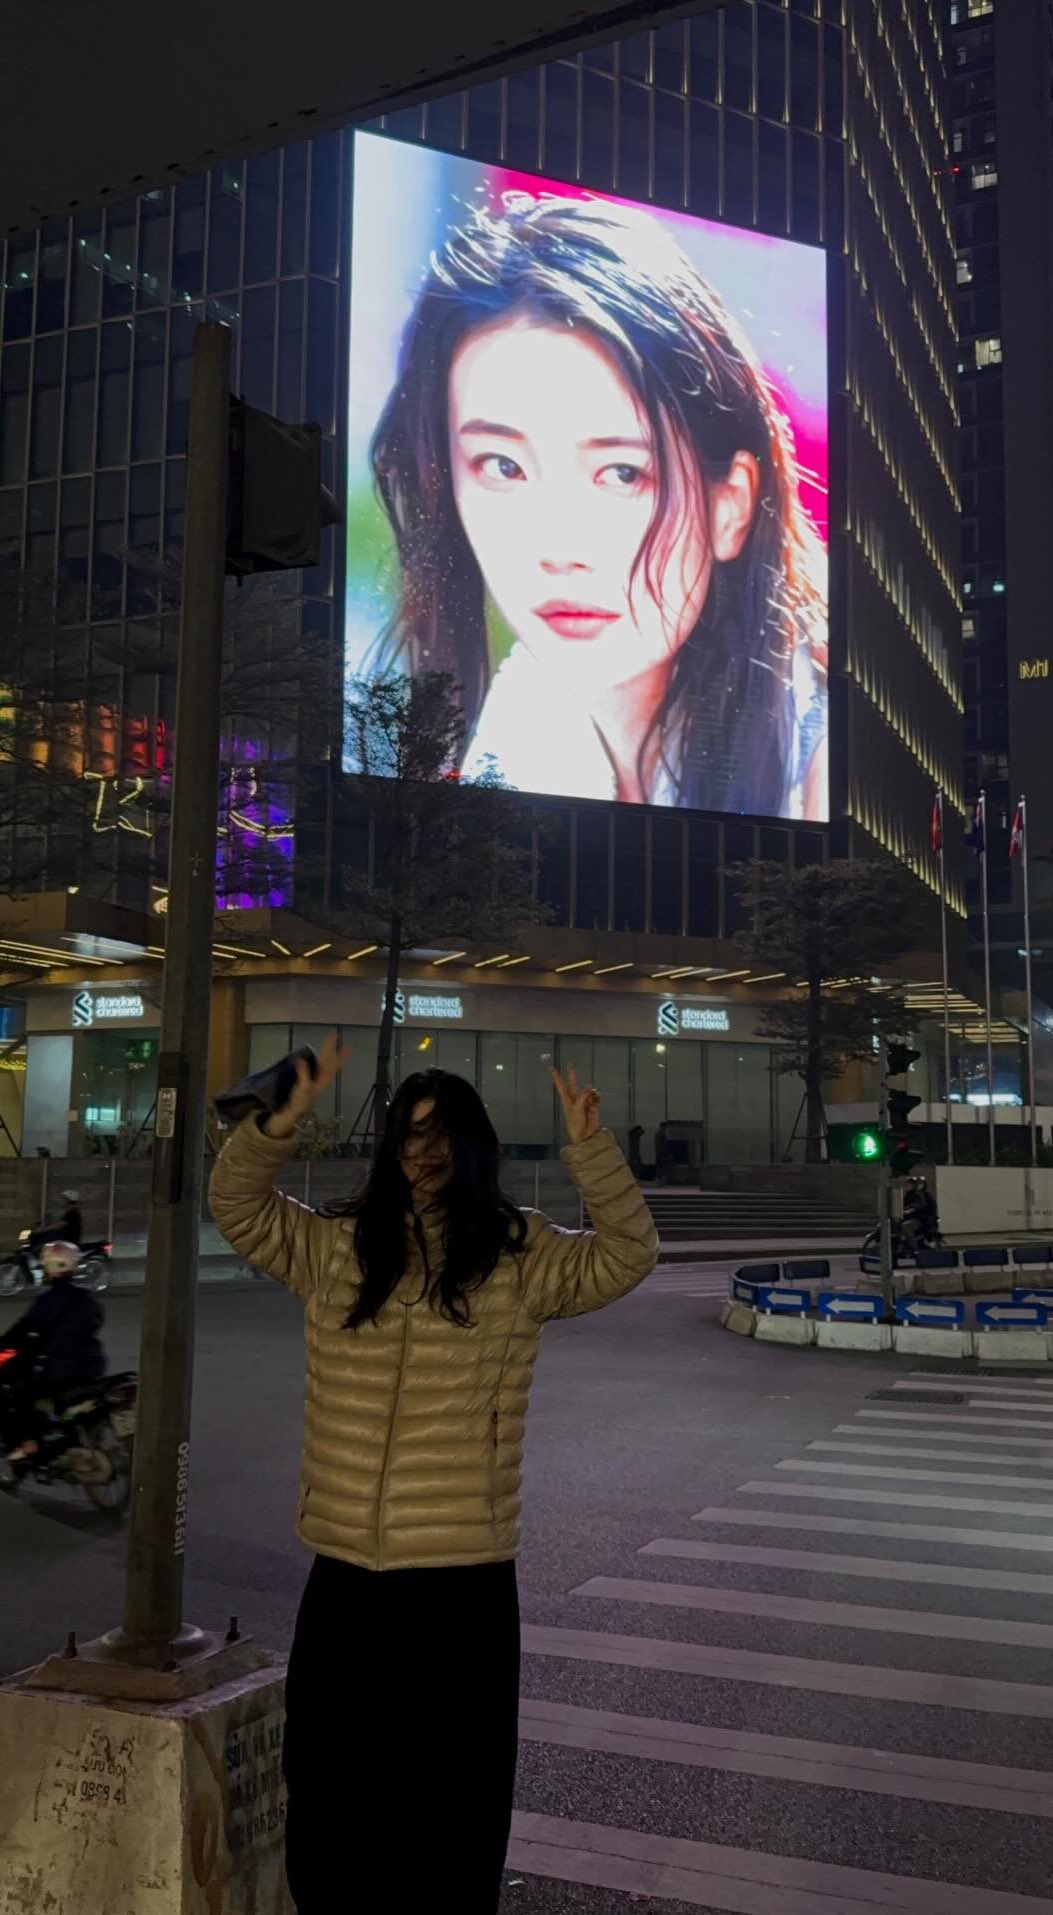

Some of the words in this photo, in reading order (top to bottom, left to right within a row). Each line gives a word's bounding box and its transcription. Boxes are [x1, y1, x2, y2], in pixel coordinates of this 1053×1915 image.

[409, 995, 460, 1007] standard
[409, 1006, 463, 1018] chartered
[681, 1008, 727, 1020] standard
[681, 1018, 729, 1030] chartered
